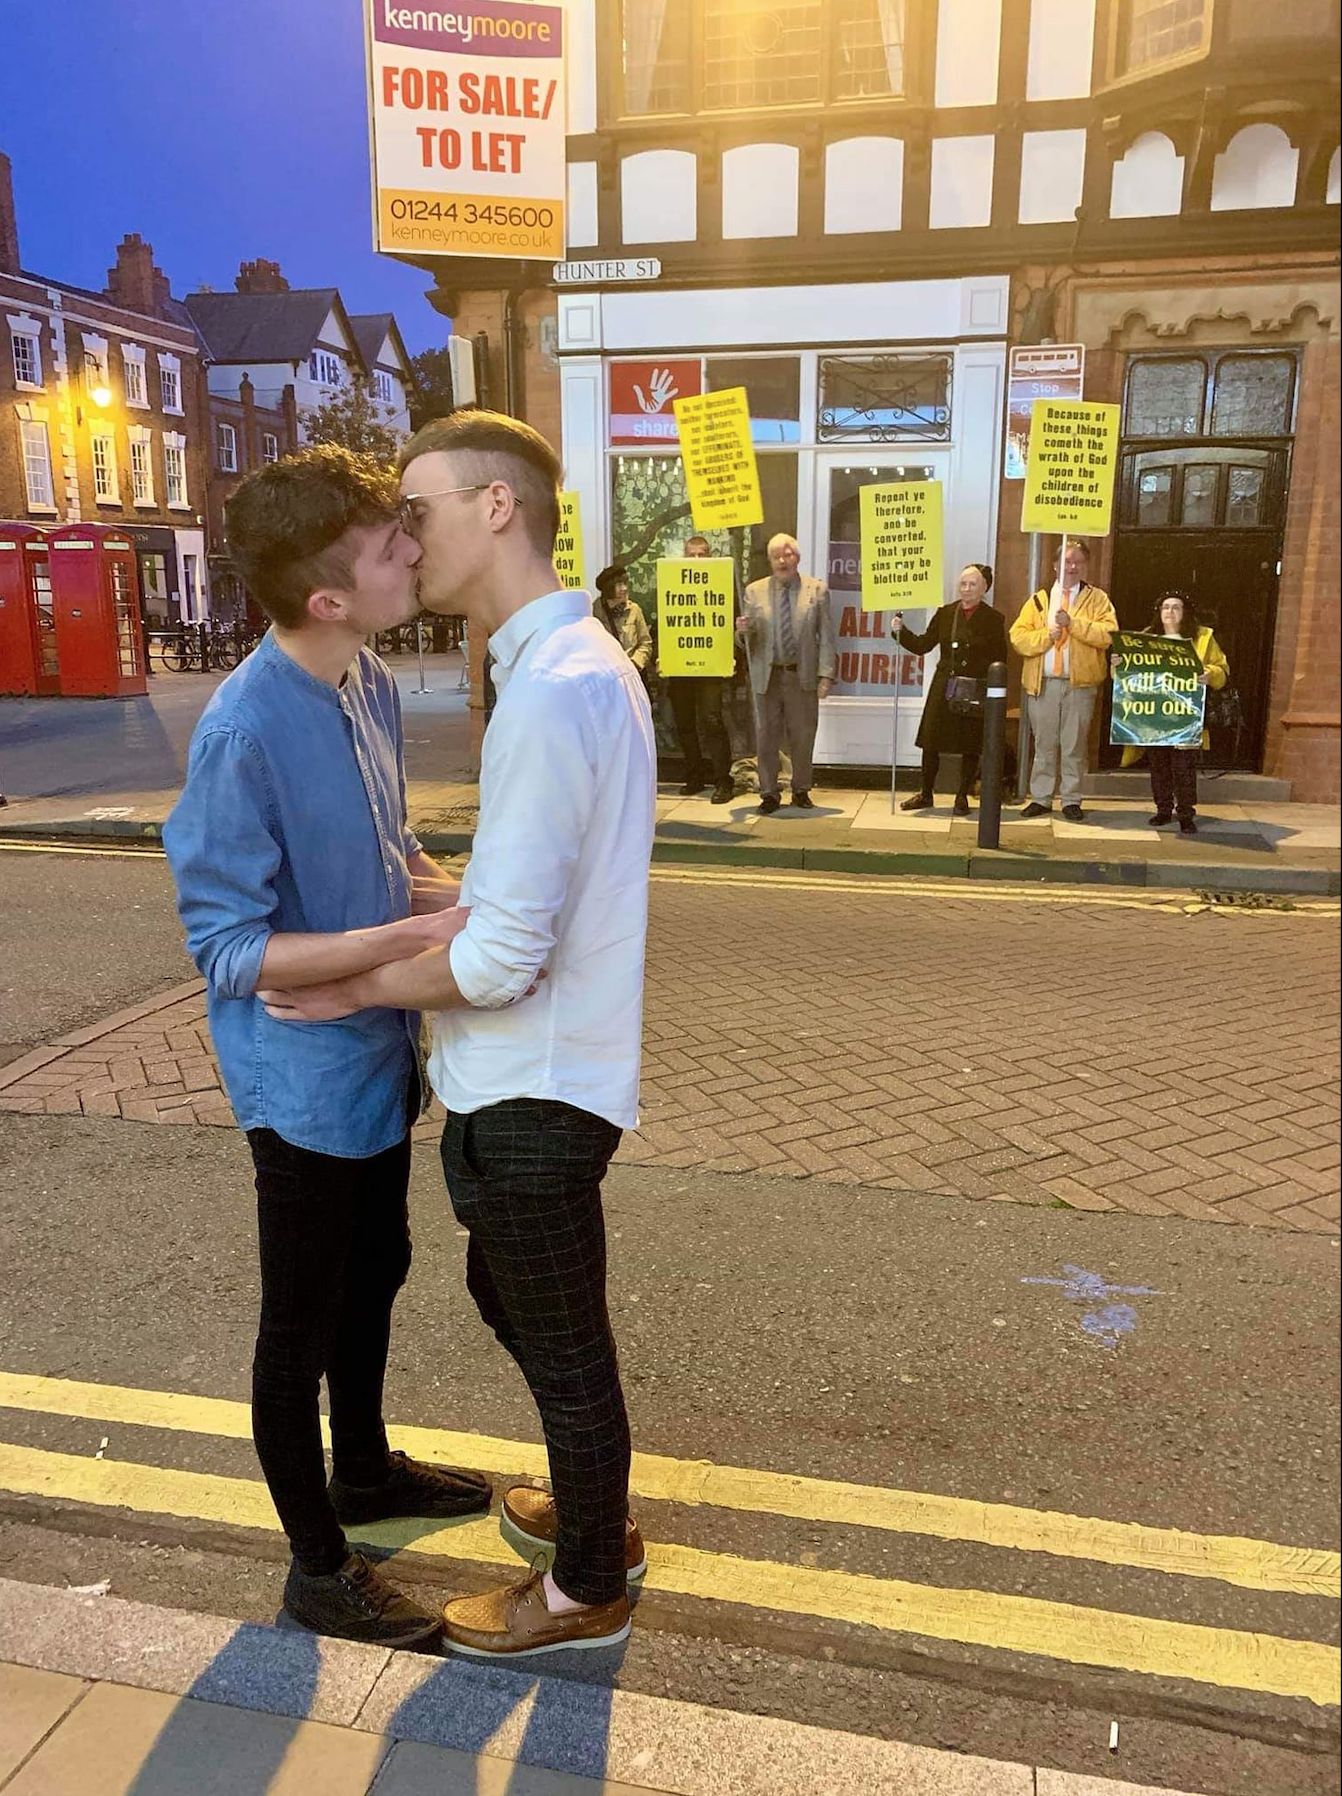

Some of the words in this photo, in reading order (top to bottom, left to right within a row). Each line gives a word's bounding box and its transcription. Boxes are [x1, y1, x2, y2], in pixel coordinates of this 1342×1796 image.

[384, 0, 551, 43] kenneymoore
[382, 66, 449, 111] FOR
[458, 72, 557, 120] SALE/
[416, 127, 461, 169] TO
[472, 131, 526, 174] LET
[391, 199, 457, 223] 01244
[464, 203, 553, 228] 345600
[391, 223, 551, 248] kenneymoore.co.uk
[557, 262, 626, 281] HUNTER
[636, 259, 657, 276] ST
[1031, 383, 1060, 394] Stop
[1047, 408, 1091, 421] Because
[1095, 411, 1106, 422] of
[1043, 422, 1072, 434] these
[1076, 424, 1108, 437] things
[1044, 436, 1083, 449] cometh
[1087, 438, 1104, 451] the
[1038, 452, 1069, 463] wrath
[1074, 452, 1084, 464] of
[1088, 453, 1108, 465] God
[1048, 467, 1073, 478] upon
[1078, 466, 1095, 479] the
[1041, 480, 1084, 492] children
[1088, 482, 1099, 493] of
[874, 493, 909, 504] Repent
[913, 490, 925, 502] ye
[1034, 494, 1103, 508] disobedience
[884, 518, 900, 530] and
[905, 517, 917, 529] be
[877, 545, 897, 557] that
[901, 545, 924, 558] your
[556, 557, 574, 571] day
[871, 559, 891, 571] sins
[919, 557, 931, 569] be
[681, 568, 709, 585] Flee
[873, 572, 909, 585] blotted
[912, 570, 928, 582] out
[665, 591, 697, 606] from
[704, 590, 725, 606] the
[666, 612, 706, 627] wrath
[712, 612, 725, 627] to
[839, 606, 886, 638] ALL
[677, 635, 713, 649] come
[1120, 634, 1144, 648] Be
[1149, 641, 1186, 654] sure
[1121, 652, 1163, 671] your
[1169, 654, 1196, 667] sin
[1120, 672, 1154, 693] will
[1161, 671, 1198, 692] find
[1121, 699, 1156, 722] you
